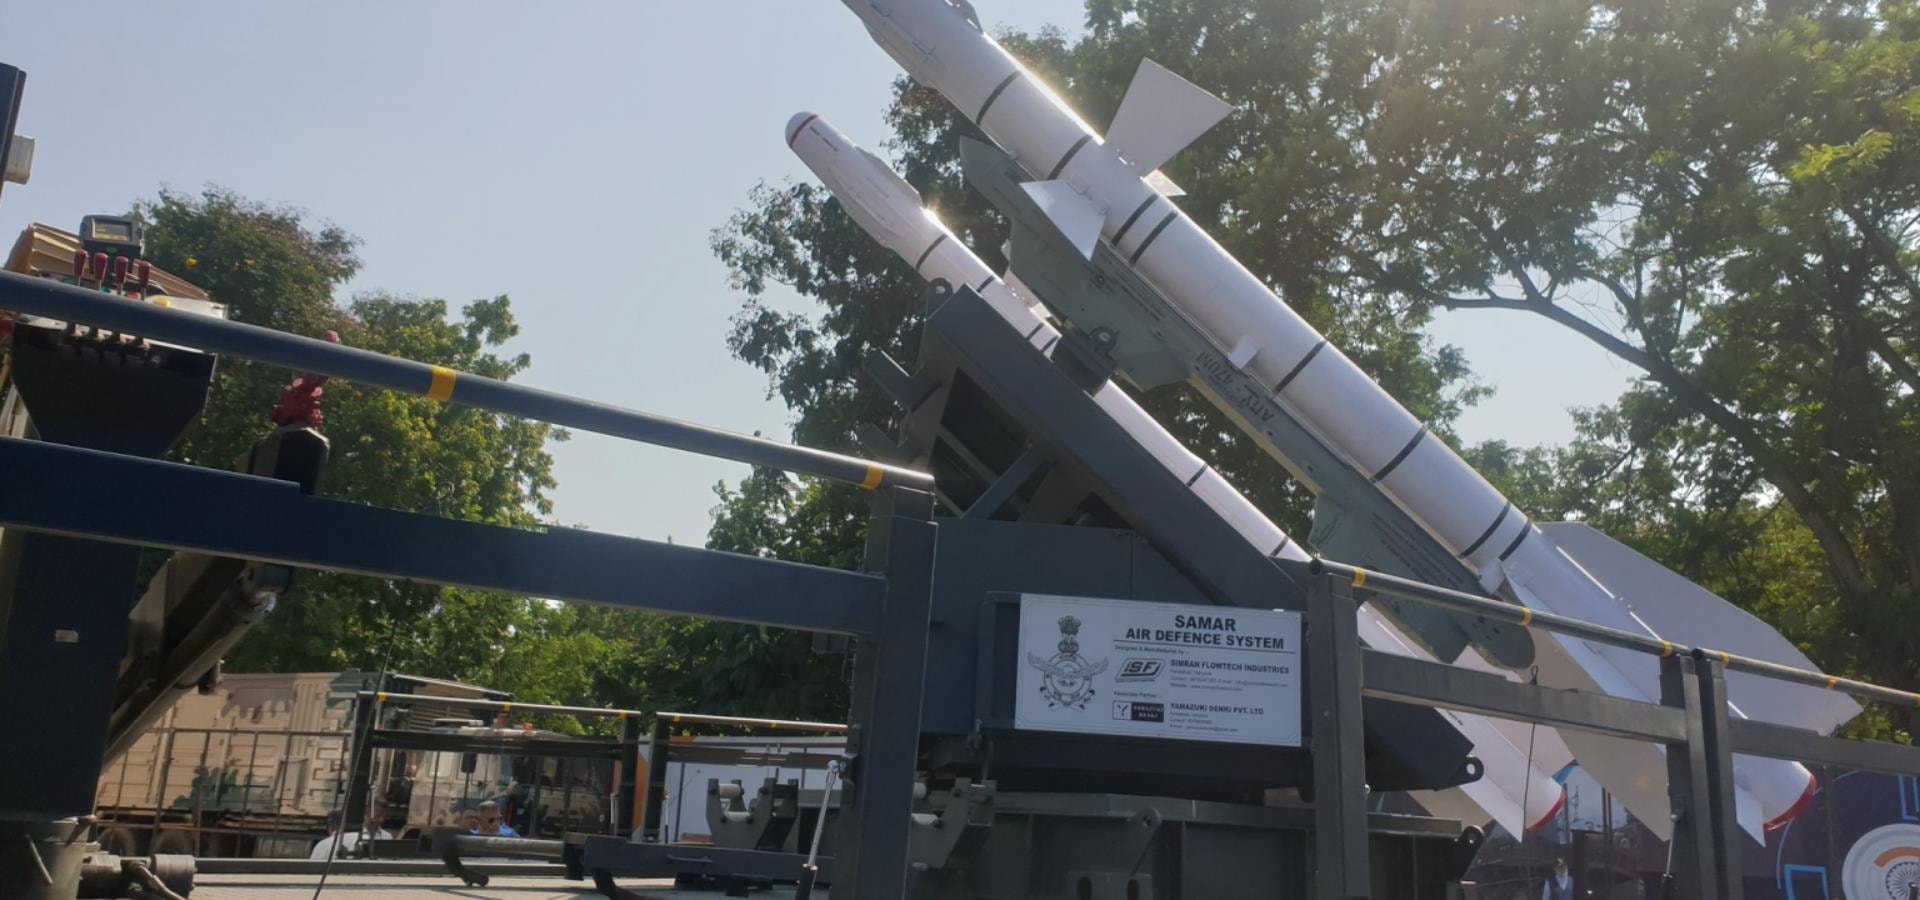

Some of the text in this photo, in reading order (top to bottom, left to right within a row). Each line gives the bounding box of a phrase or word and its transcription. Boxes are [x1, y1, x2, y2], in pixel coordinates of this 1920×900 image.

[1174, 614, 1236, 632] SAMAR
[1126, 627, 1284, 649] AIR DEFENCE SYSTEM
[1170, 659, 1290, 674] SIMRAN FLOWTECH INDUSTRIES
[1170, 702, 1208, 711] YAMAZUKI
[1208, 704, 1232, 713] DENKI
